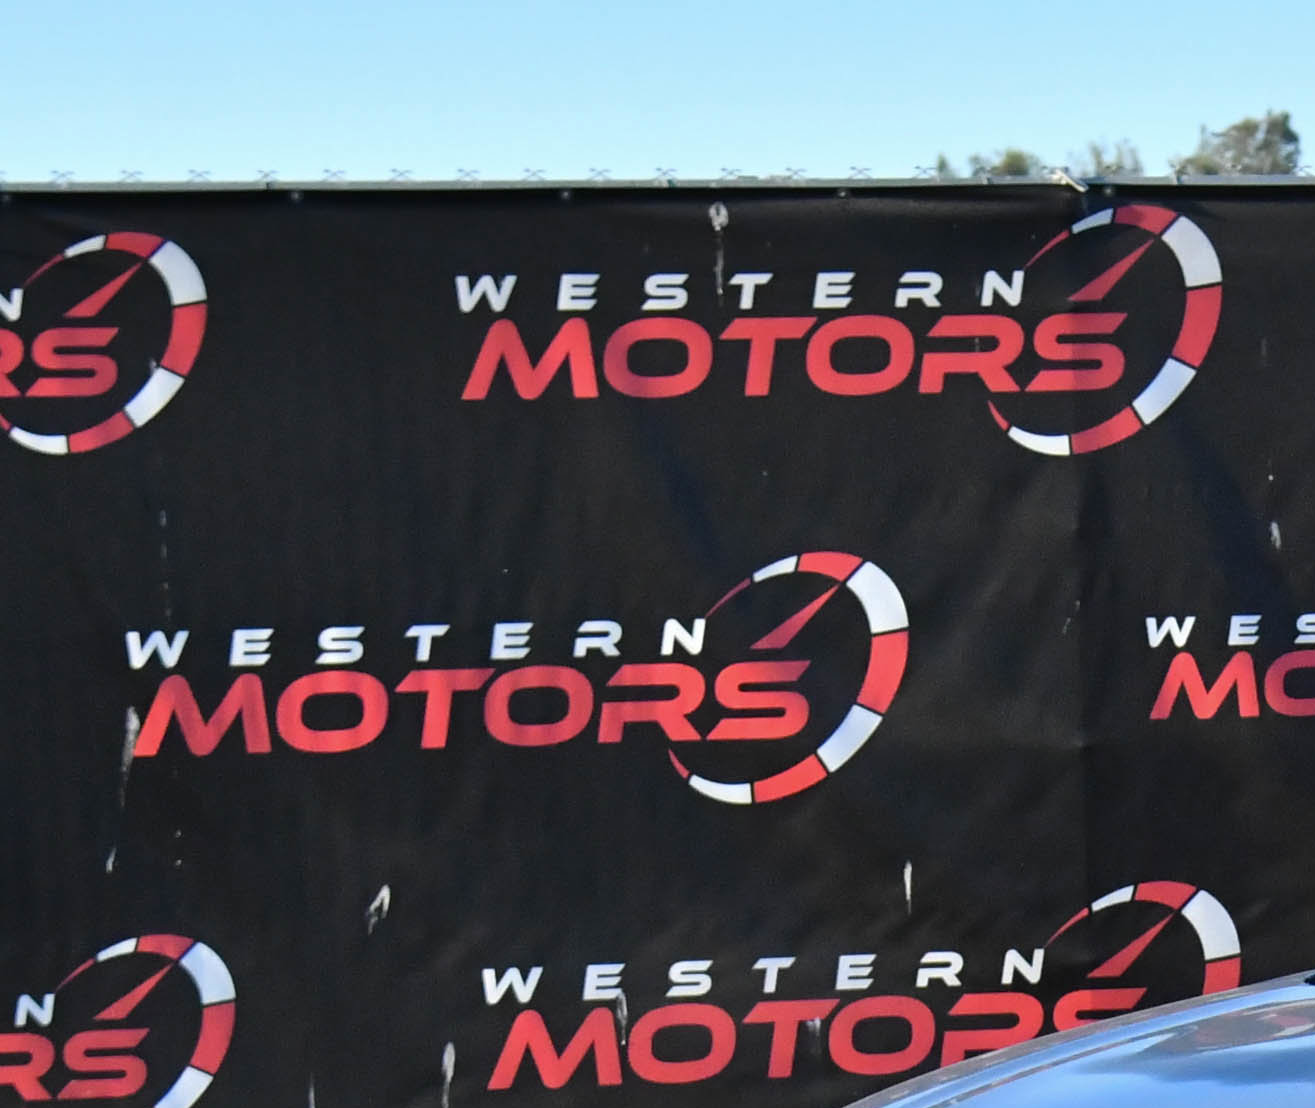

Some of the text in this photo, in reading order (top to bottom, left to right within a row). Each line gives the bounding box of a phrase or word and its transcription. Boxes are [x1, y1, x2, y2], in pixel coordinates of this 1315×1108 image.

[455, 270, 1025, 313] WESTERN
[461, 313, 1127, 400] MOTORS
[125, 618, 707, 670] WESTERN
[132, 660, 812, 757] MOTORS
[481, 948, 1045, 1005] WESTERN
